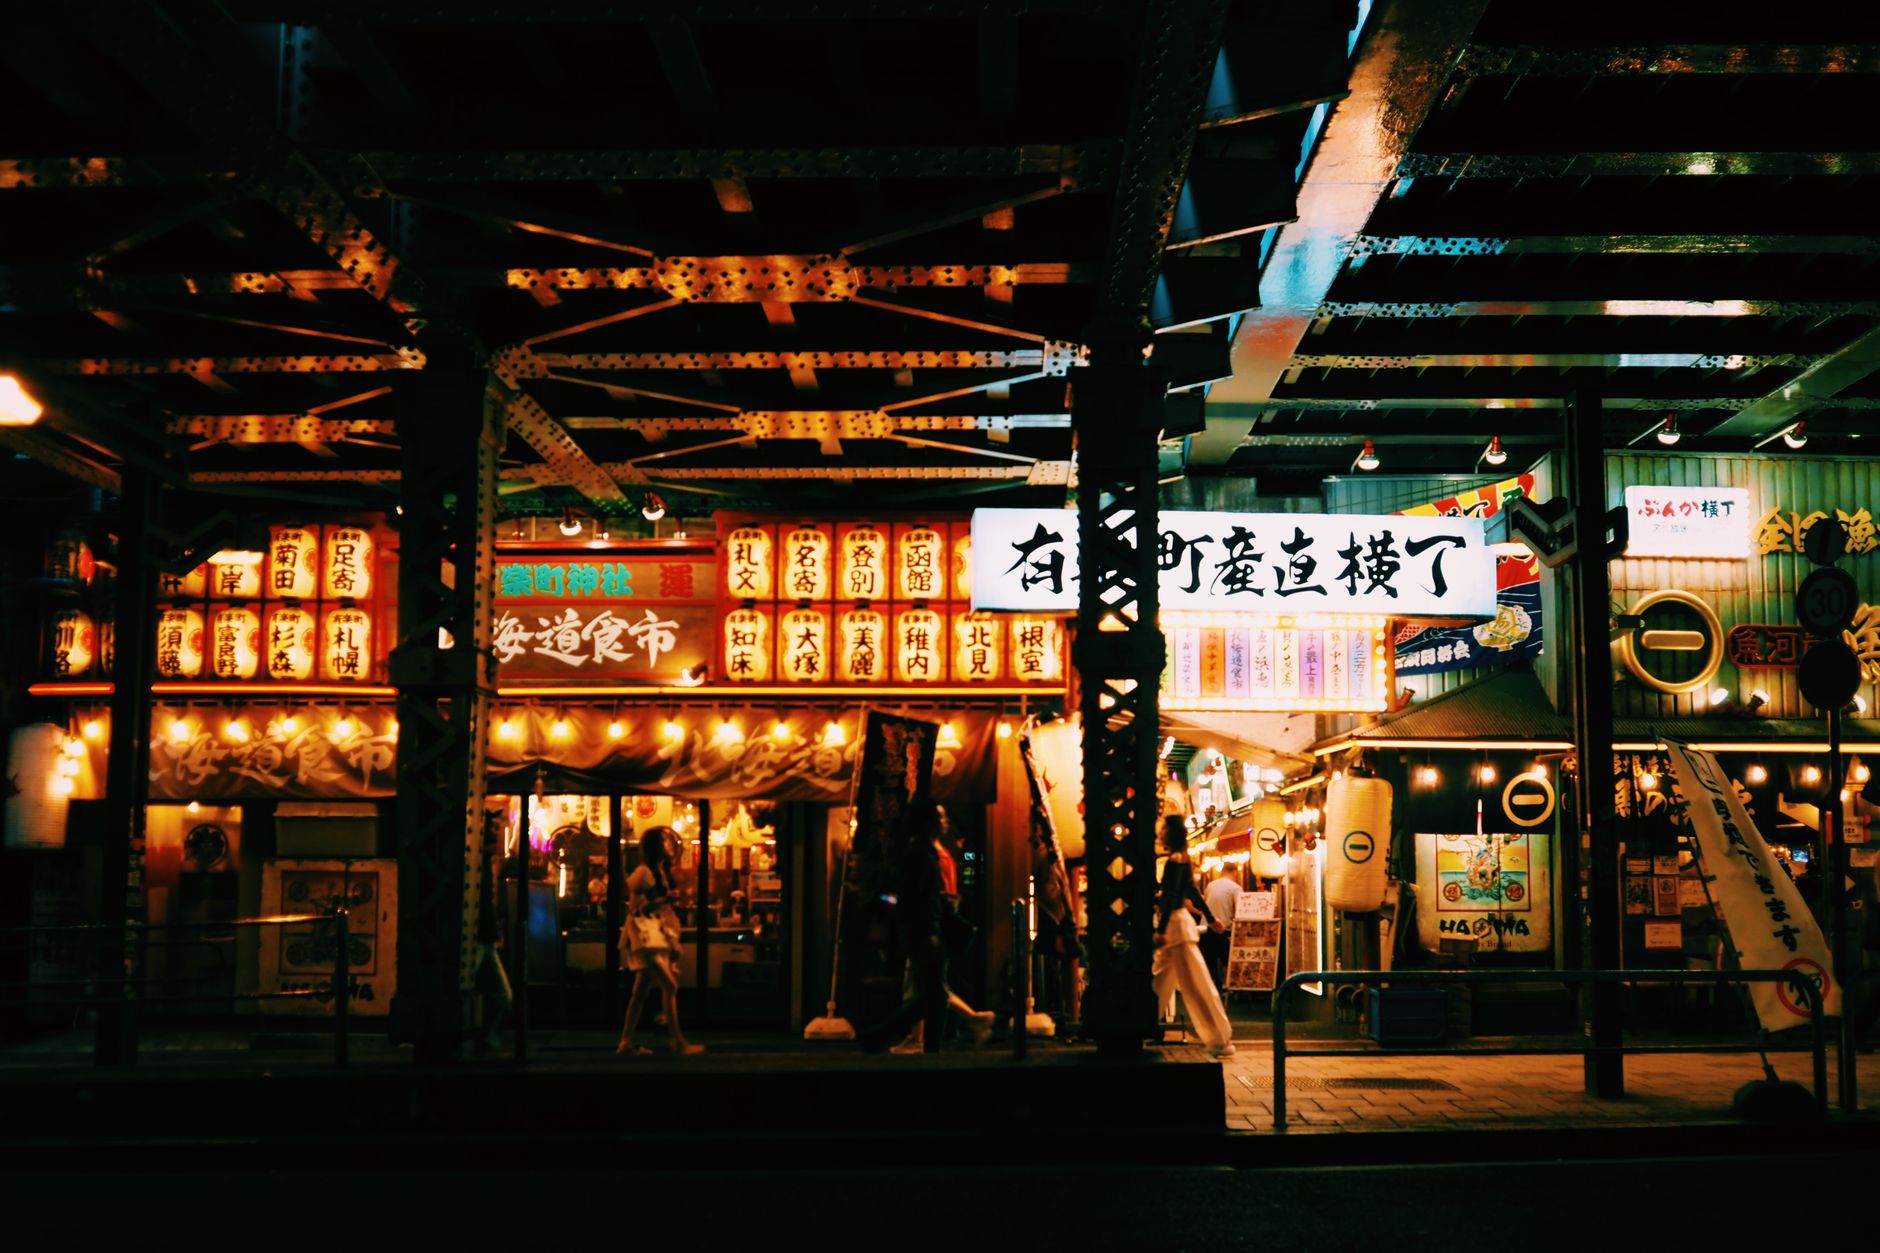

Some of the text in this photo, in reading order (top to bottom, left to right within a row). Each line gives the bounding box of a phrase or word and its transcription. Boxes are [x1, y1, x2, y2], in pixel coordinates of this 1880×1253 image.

[1638, 498, 1735, 519] ぶんか横丁
[275, 544, 298, 590] 菊田
[332, 544, 356, 592] 足寄
[734, 543, 759, 591] 礼文
[793, 545, 817, 594] 名寄
[851, 545, 875, 594] 登別
[906, 544, 933, 592] 函館
[1003, 522, 1467, 599] 有町産直横丁
[1810, 586, 1843, 618] 30
[218, 625, 240, 674] 富良野
[271, 626, 295, 672] 杉森
[332, 627, 359, 675] 札幌
[731, 627, 756, 674] 知床
[794, 627, 820, 675] 大塚
[904, 627, 930, 675] 稚内
[966, 626, 991, 675] 北見
[1019, 626, 1044, 673] 根室
[1735, 630, 1823, 664] 魚河
